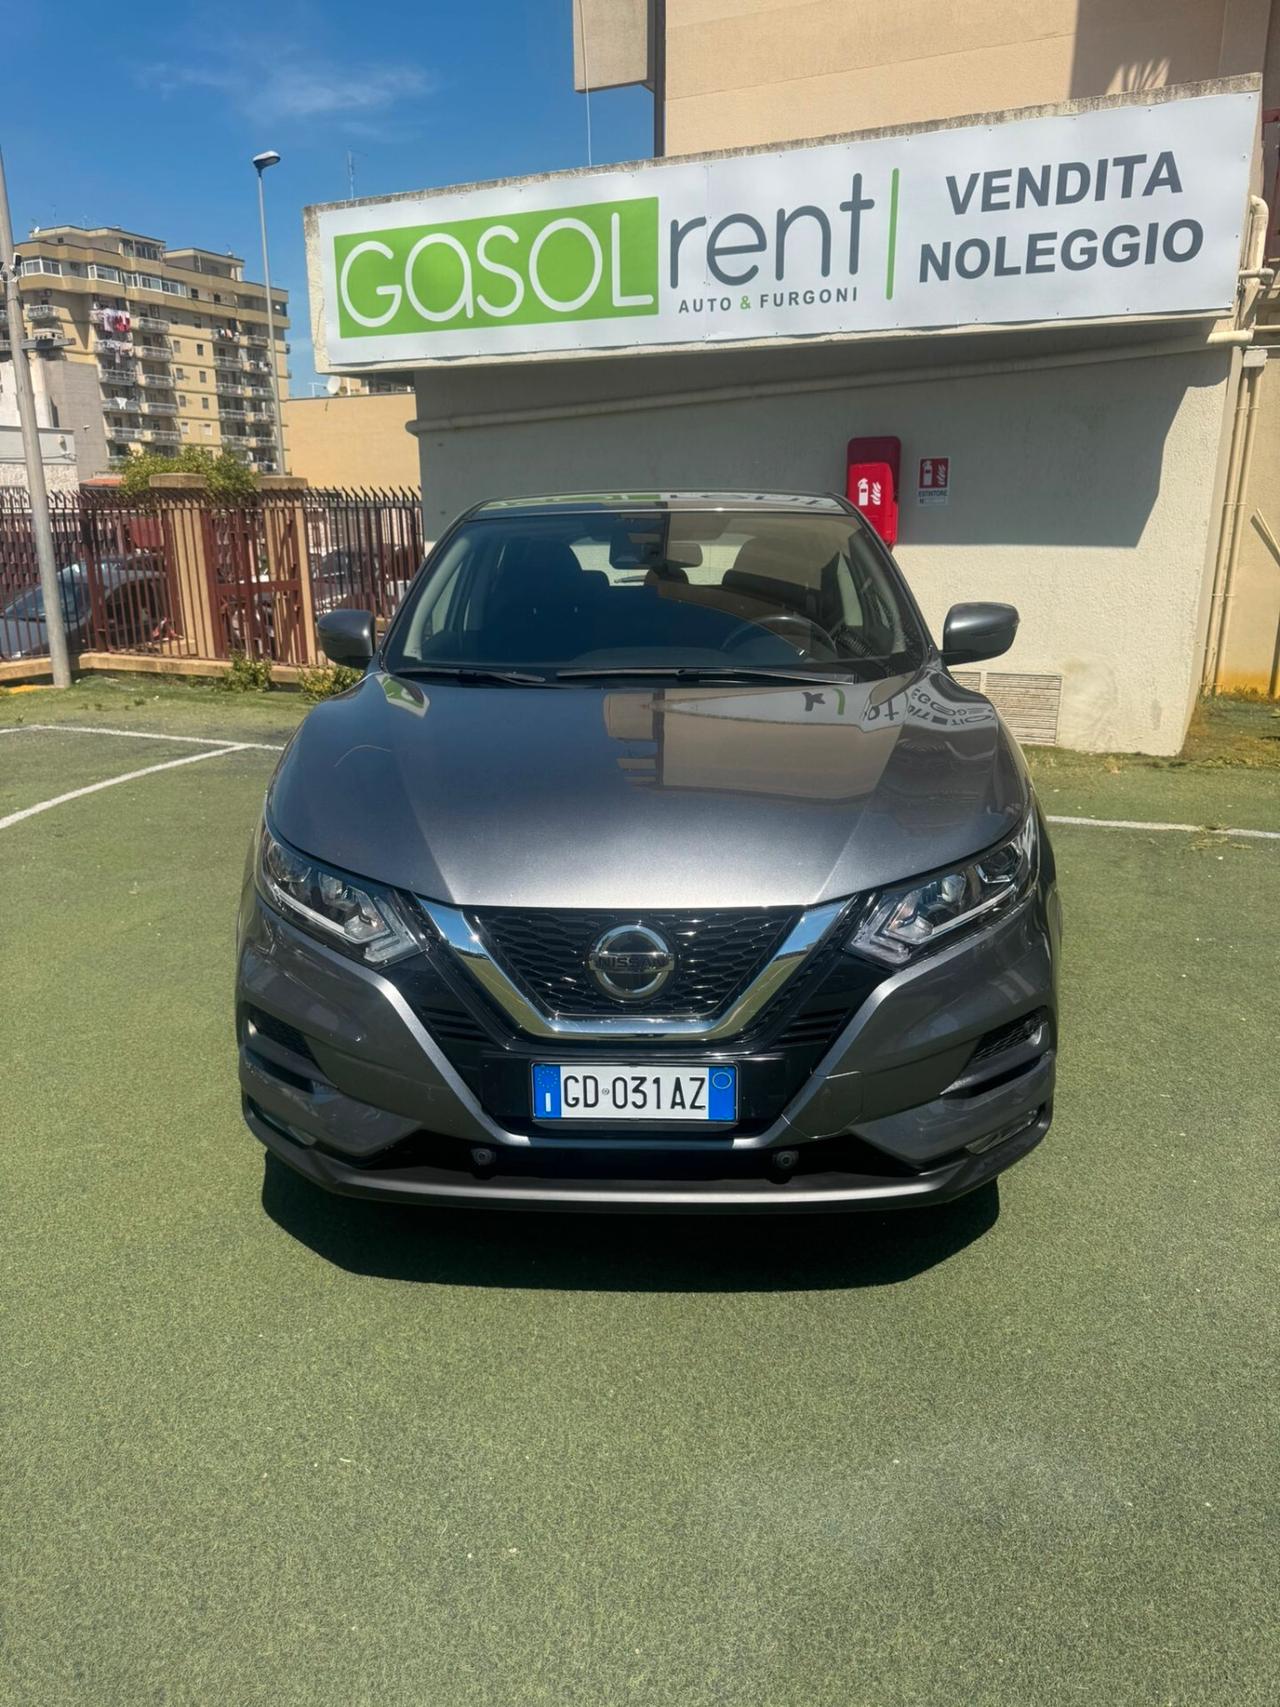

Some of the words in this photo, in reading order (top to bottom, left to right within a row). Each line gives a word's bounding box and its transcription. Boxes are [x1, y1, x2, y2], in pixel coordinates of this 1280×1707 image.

[945, 151, 1183, 214] VENDITA
[670, 173, 874, 288] rent
[919, 219, 1204, 282] NOLEGGIO
[678, 297, 732, 312] AUTO
[740, 295, 753, 309] &
[760, 287, 858, 308] FURGONI
[600, 956, 668, 969] NISSAN
[563, 1075, 599, 1109] GD
[612, 1076, 706, 1110] 031AZ
